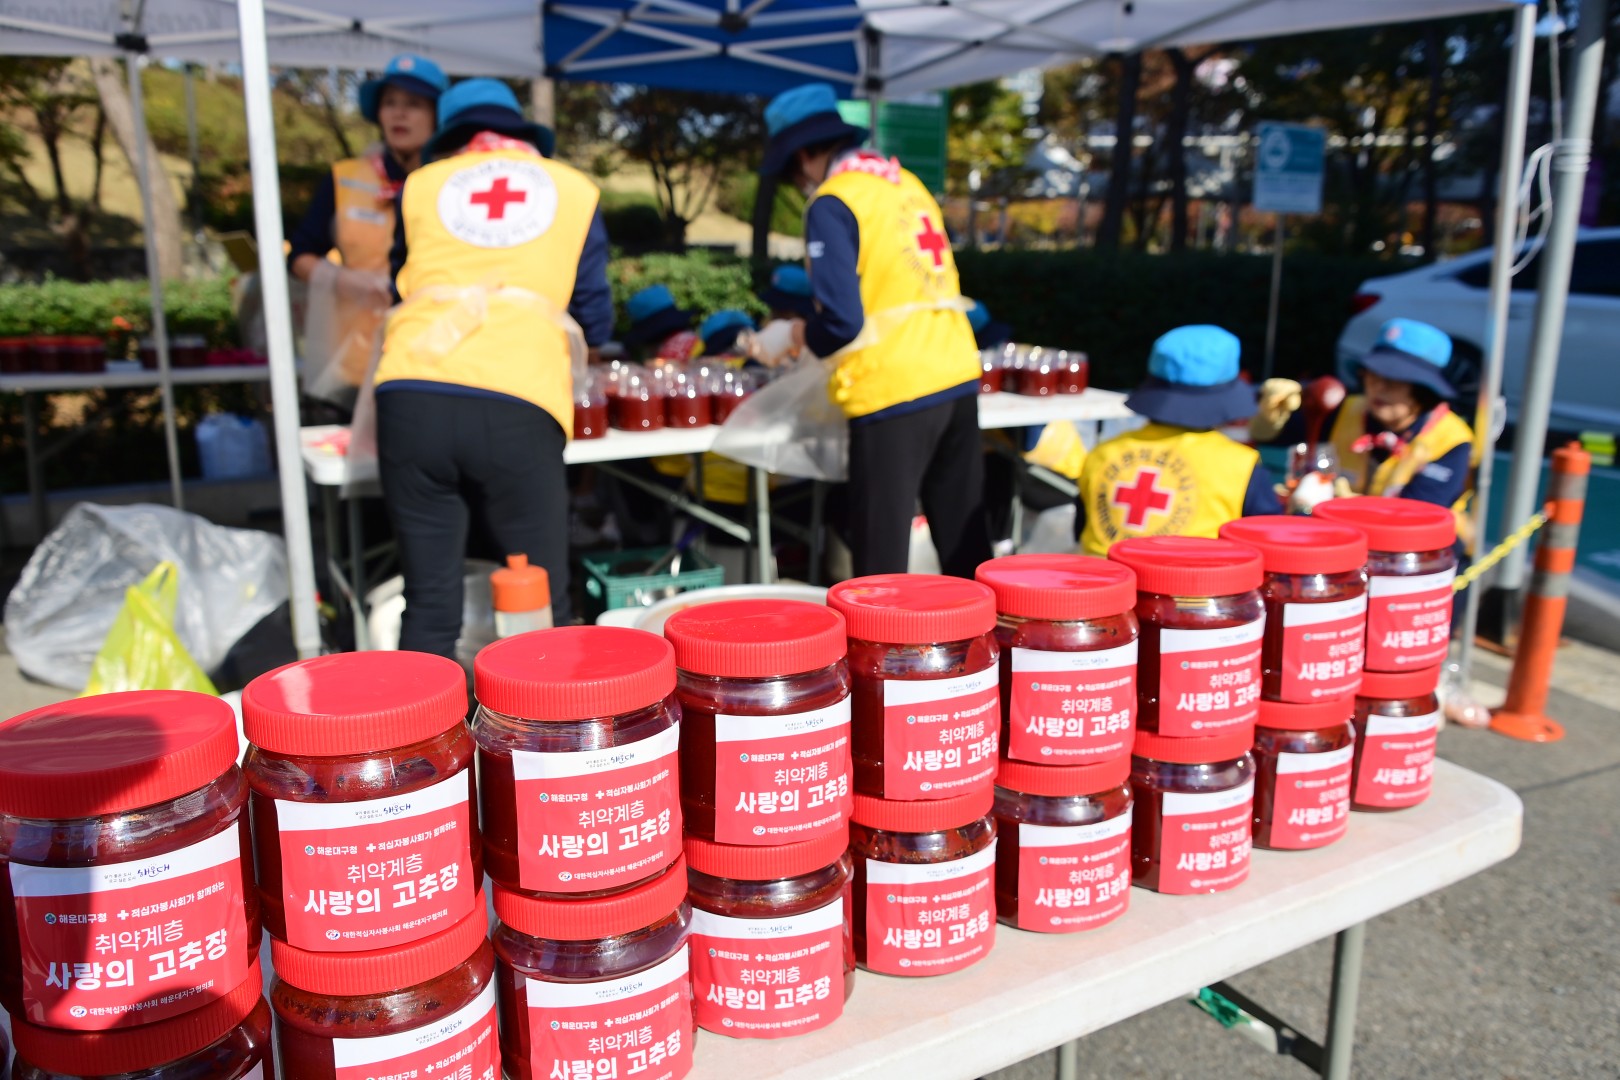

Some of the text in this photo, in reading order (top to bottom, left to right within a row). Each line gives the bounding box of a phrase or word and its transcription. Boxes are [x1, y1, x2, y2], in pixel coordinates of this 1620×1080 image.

[1382, 629, 1429, 648] 사랑의
[1298, 661, 1345, 681] 사랑의
[1061, 697, 1112, 714] 취약계층
[1176, 691, 1229, 711] 사랑의
[939, 721, 984, 744] 취약계층
[1026, 709, 1130, 737] 사랑의 고추장
[751, 753, 784, 762] 해운대구청
[903, 747, 961, 771] 사랑의
[775, 762, 828, 786] 취약계층
[551, 793, 588, 802] 해운대구청
[606, 779, 651, 797] 적십자봉사회가
[735, 773, 848, 814] 사랑의 고추장
[579, 800, 644, 828] 취약계층
[317, 821, 456, 854] 해운대구청 적십자봉사회가 함께하는
[539, 808, 670, 858] 사랑의 고추장
[348, 854, 423, 884] 취약계층
[574, 865, 625, 879] 대한적십자사봉사회
[1177, 850, 1227, 871] 사랑의
[59, 881, 224, 924] 해운대구청 적십자봉사회가 함께하는
[304, 863, 459, 915] 사랑의 고추장
[1035, 887, 1090, 907] 사랑의
[343, 909, 448, 938] 대한적십자사봉사회 해운대지구협의회
[918, 904, 970, 925] 취약계층
[95, 920, 183, 954] 취약계층
[884, 910, 989, 949] 사랑의 고추장
[46, 928, 226, 990] 사랑의 고추장
[740, 966, 800, 985] 취약계층
[90, 980, 214, 1015] 대한적십자사봉사회 해운대지구협의회
[707, 976, 831, 1010] 사랑의 고추장
[562, 1020, 597, 1030] 해운대구청
[615, 1006, 660, 1024] 적십자봉사회가
[588, 1026, 652, 1054] 취약계층
[436, 1042, 477, 1069] 적십자봉사회가
[550, 1029, 681, 1080] 사랑의 고추장
